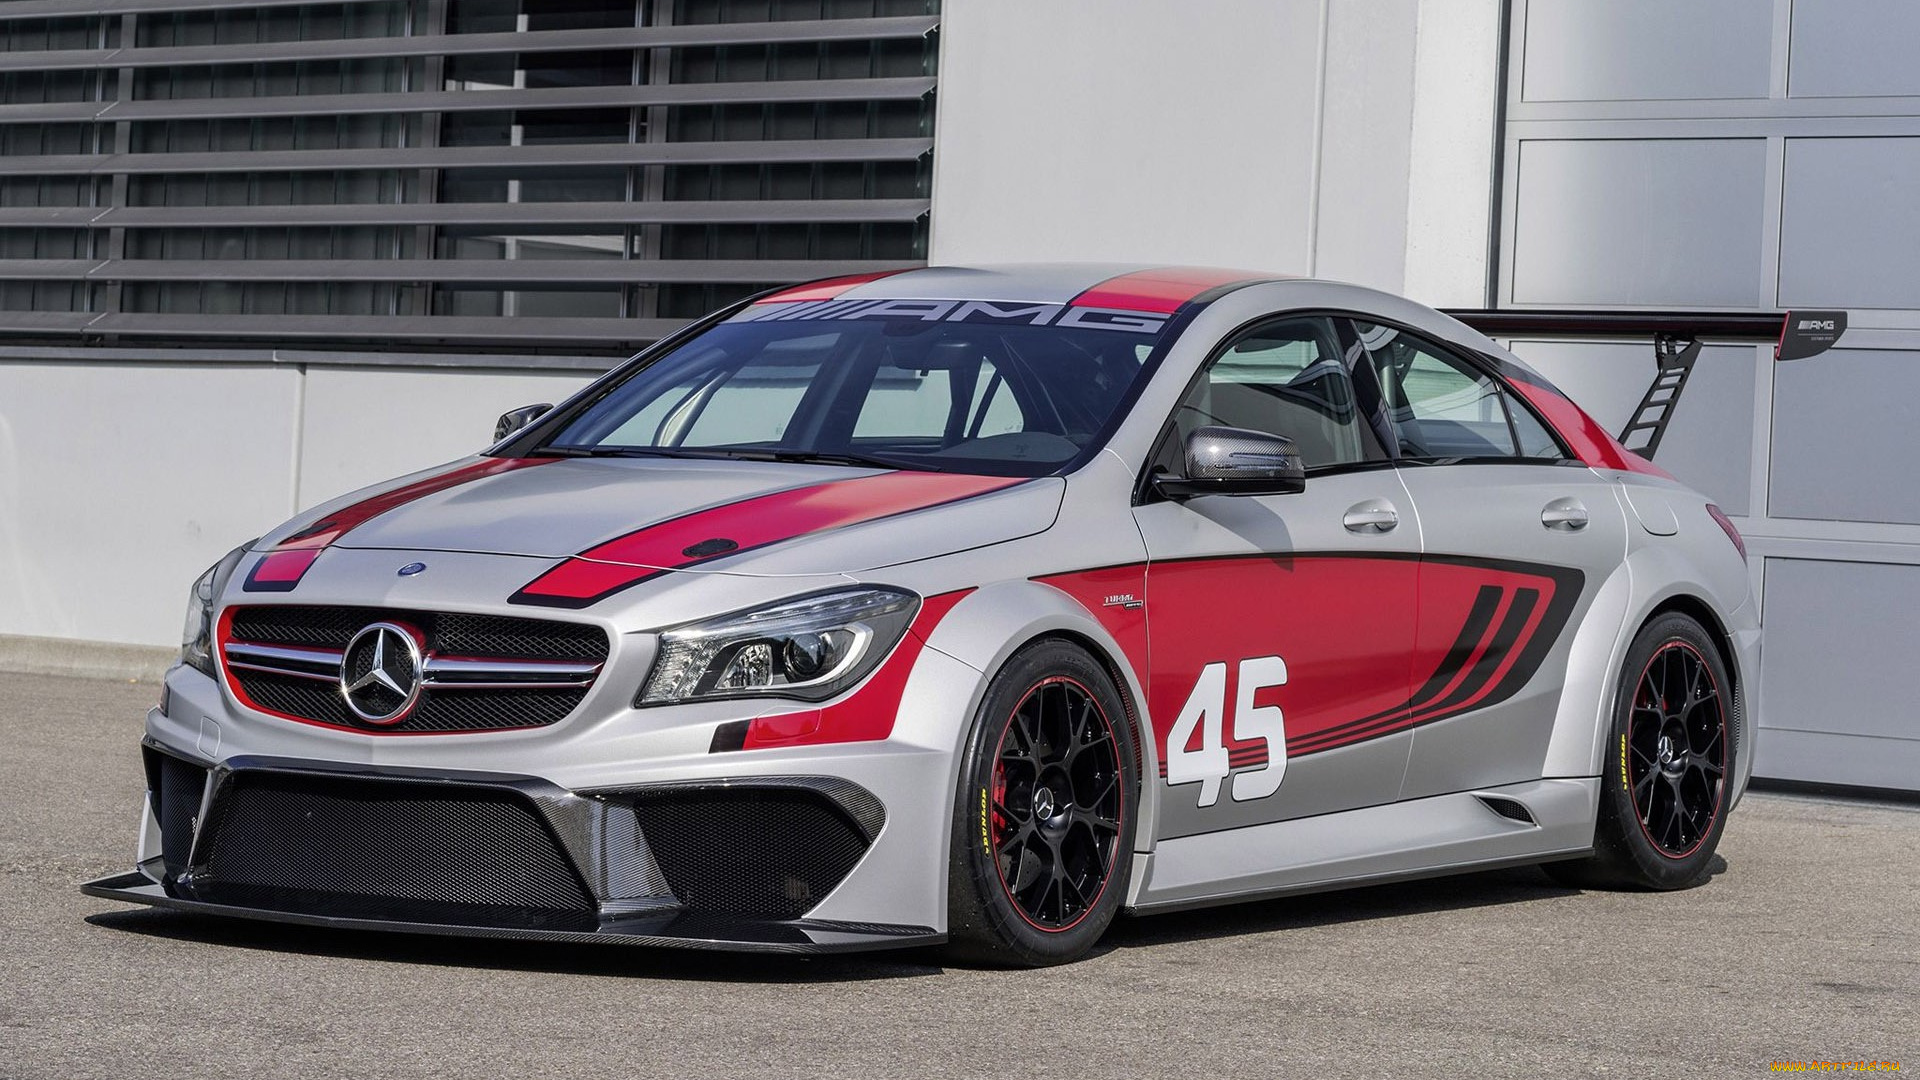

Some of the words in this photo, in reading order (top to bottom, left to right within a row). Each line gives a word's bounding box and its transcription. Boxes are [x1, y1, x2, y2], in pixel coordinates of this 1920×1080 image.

[839, 300, 1173, 333] AMG
[1810, 320, 1834, 330] AMG
[1167, 655, 1288, 807] 45
[981, 788, 989, 847] DUNLOP
